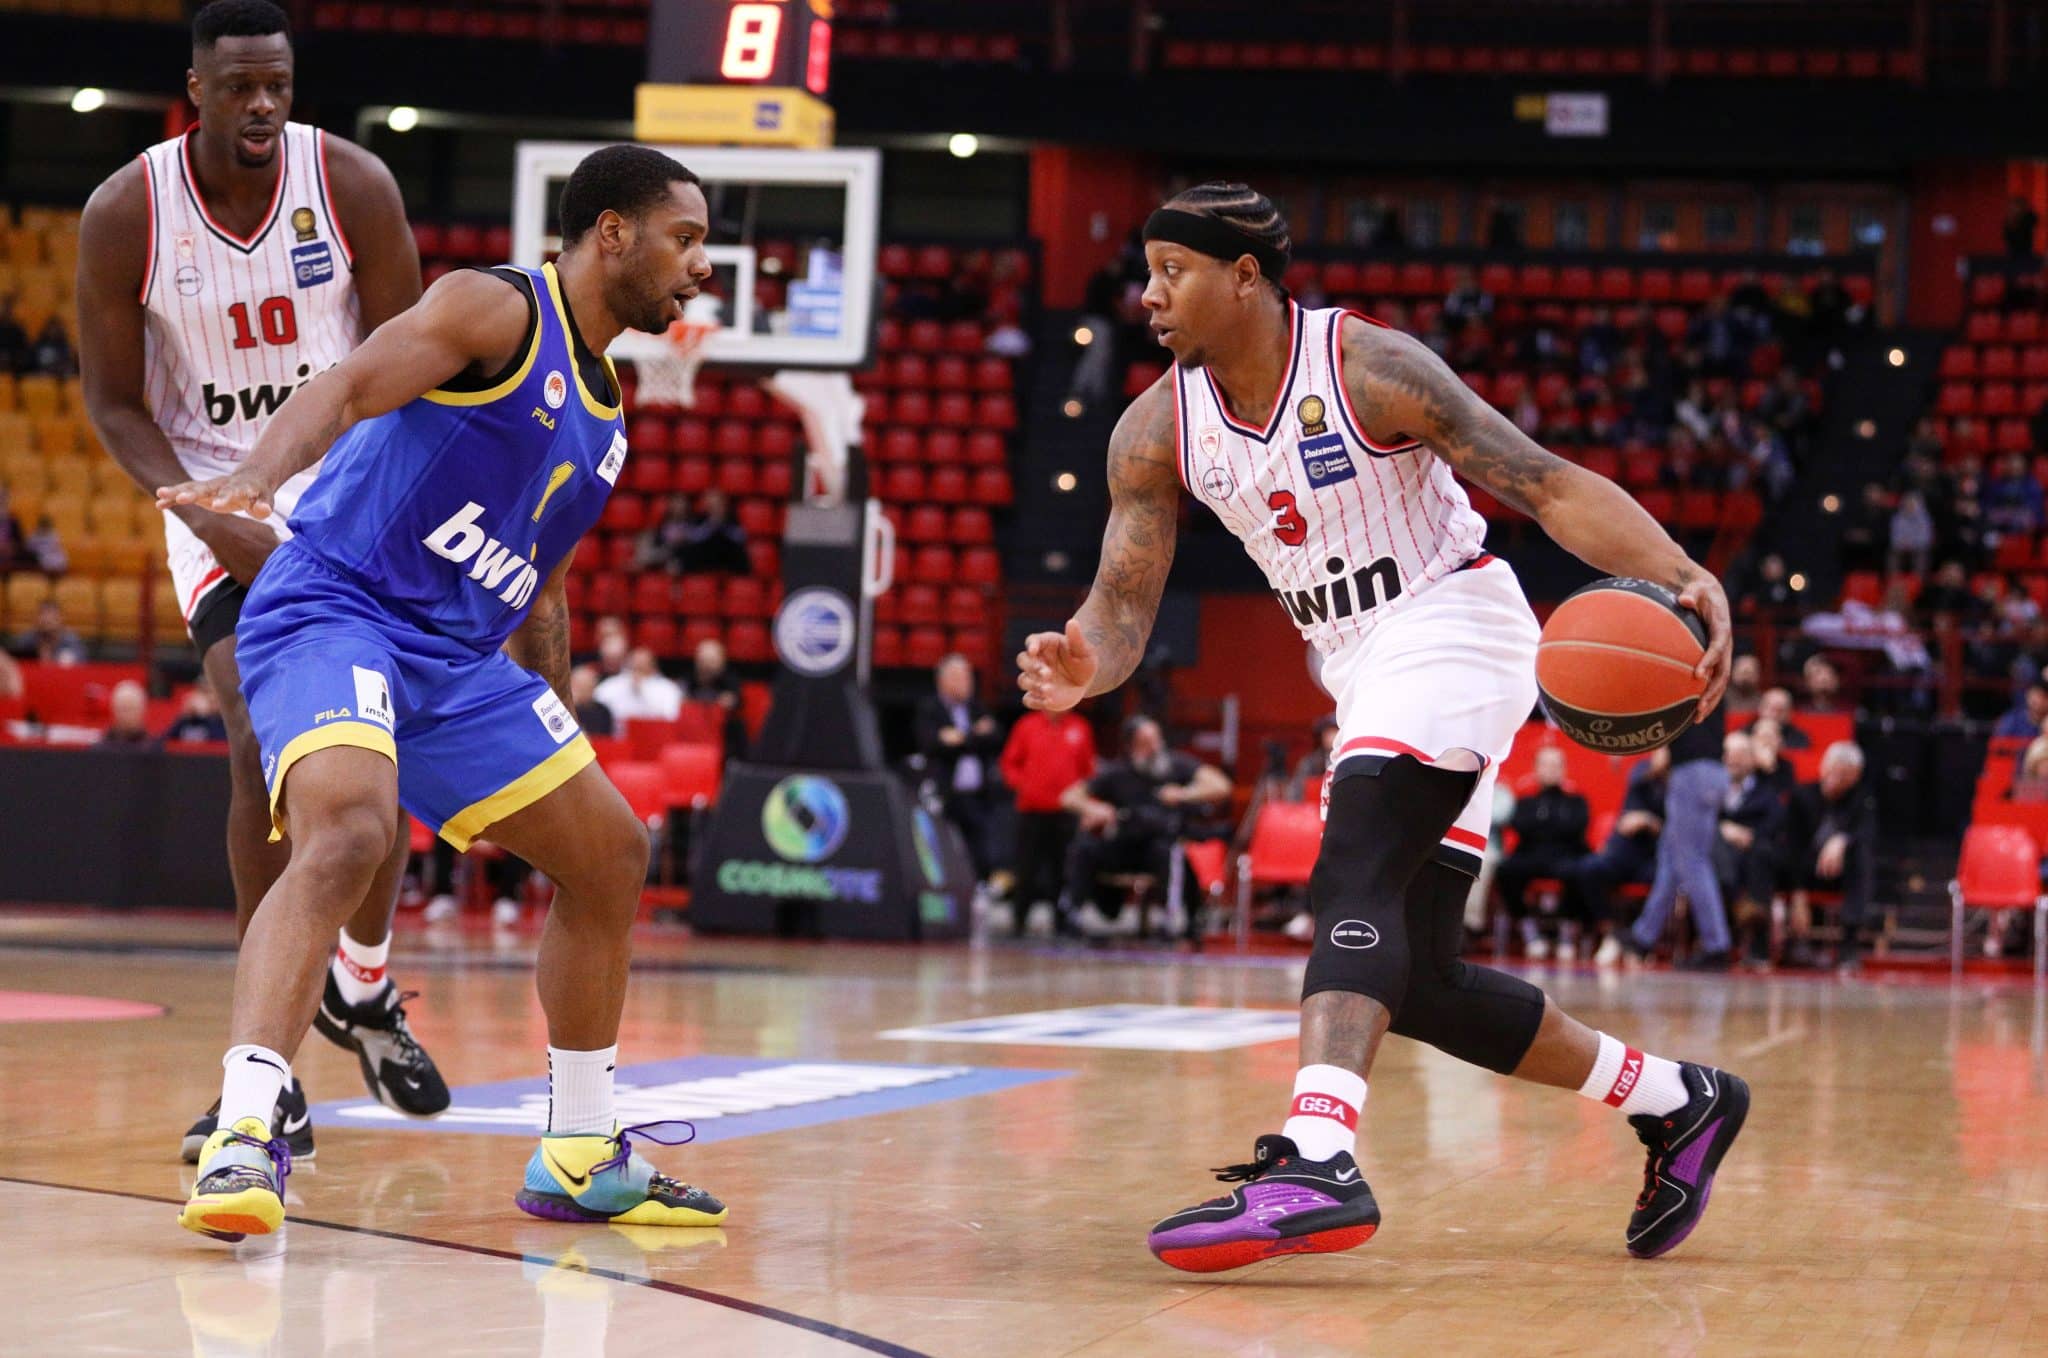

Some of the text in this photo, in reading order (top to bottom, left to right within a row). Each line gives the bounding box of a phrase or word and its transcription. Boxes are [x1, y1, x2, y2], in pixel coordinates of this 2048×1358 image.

[720, 3, 783, 80] 8
[228, 295, 299, 349] 10
[202, 363, 337, 425] bw
[531, 406, 556, 431] FILA
[531, 460, 576, 523] 1
[1268, 490, 1308, 546] 3
[421, 501, 539, 611] bwin
[314, 707, 352, 724] FILA
[1551, 710, 1667, 748] PALDING
[1612, 1058, 1641, 1098] GSA
[1299, 1096, 1347, 1121] GSA
